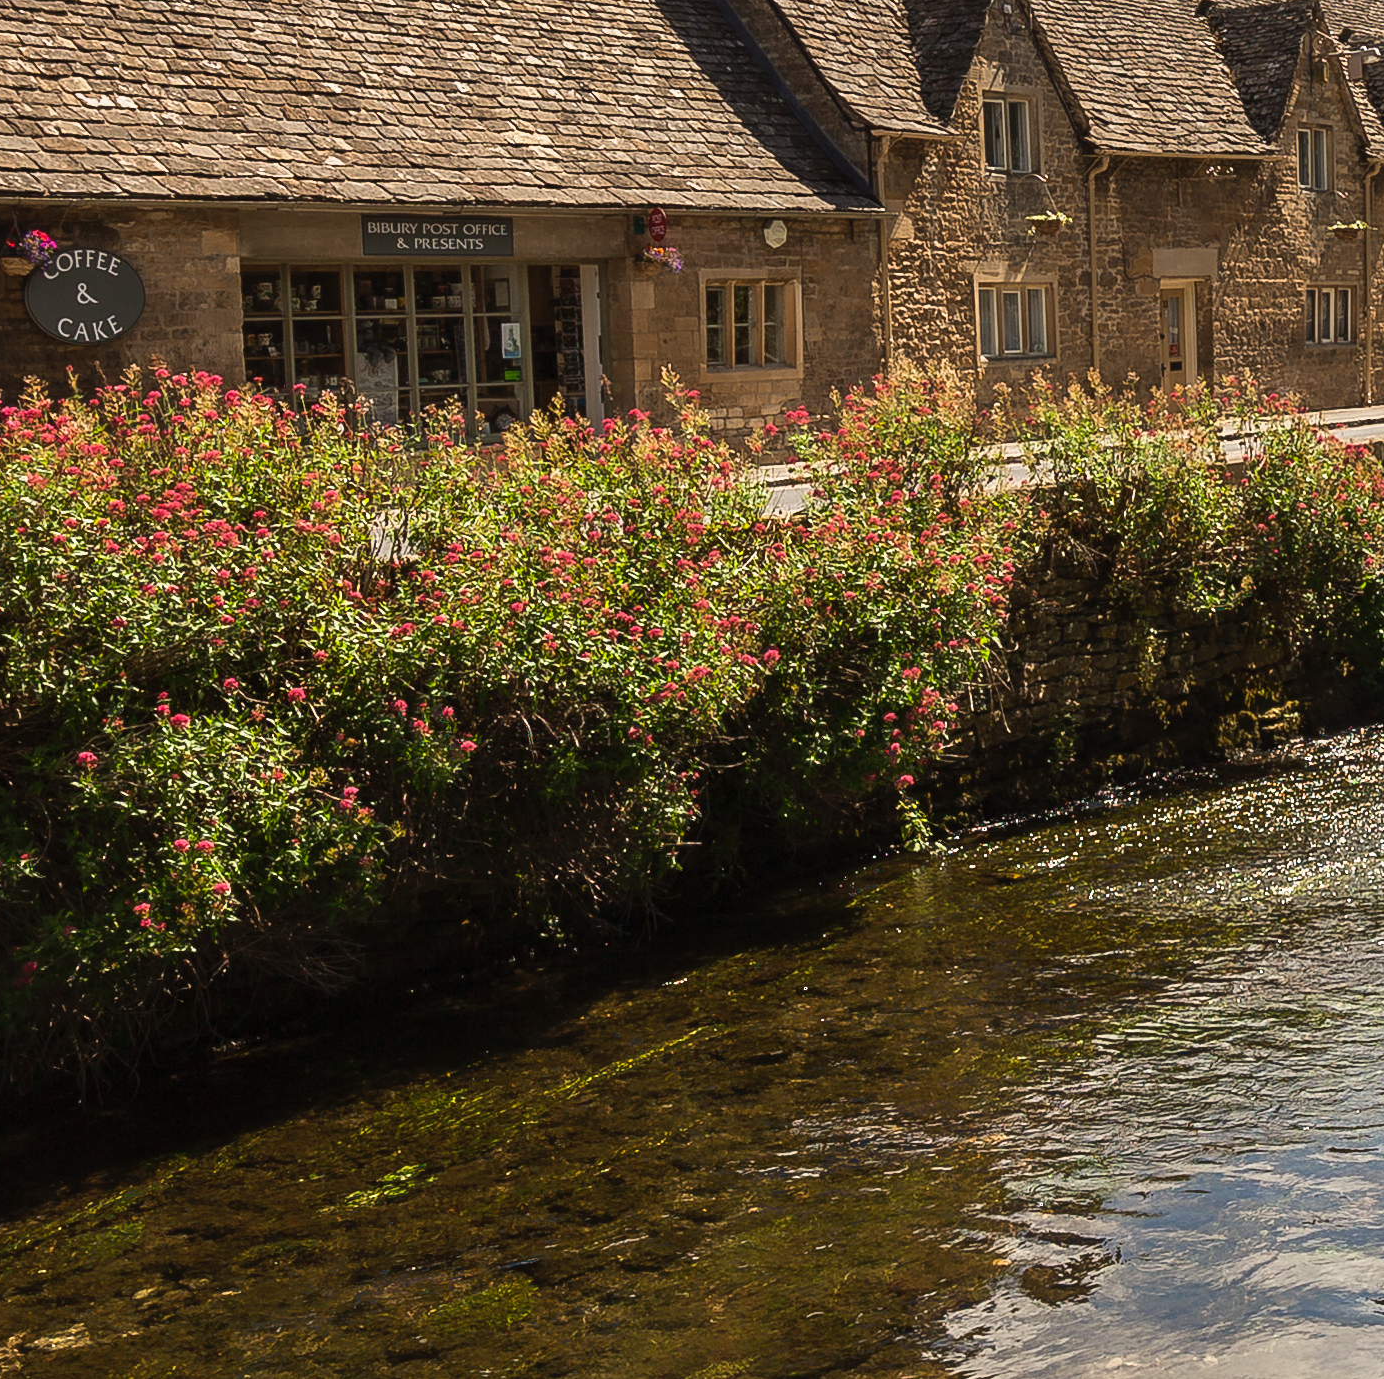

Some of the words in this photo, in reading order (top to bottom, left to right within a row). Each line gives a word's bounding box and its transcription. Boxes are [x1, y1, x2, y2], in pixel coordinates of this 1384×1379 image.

[367, 222, 418, 234] BIBURY
[422, 223, 459, 235] POST
[462, 223, 509, 236] OFFICE
[396, 237, 410, 249] &
[414, 237, 484, 250] PRESENTS
[76, 282, 99, 305] &
[57, 314, 123, 341] CAKE
